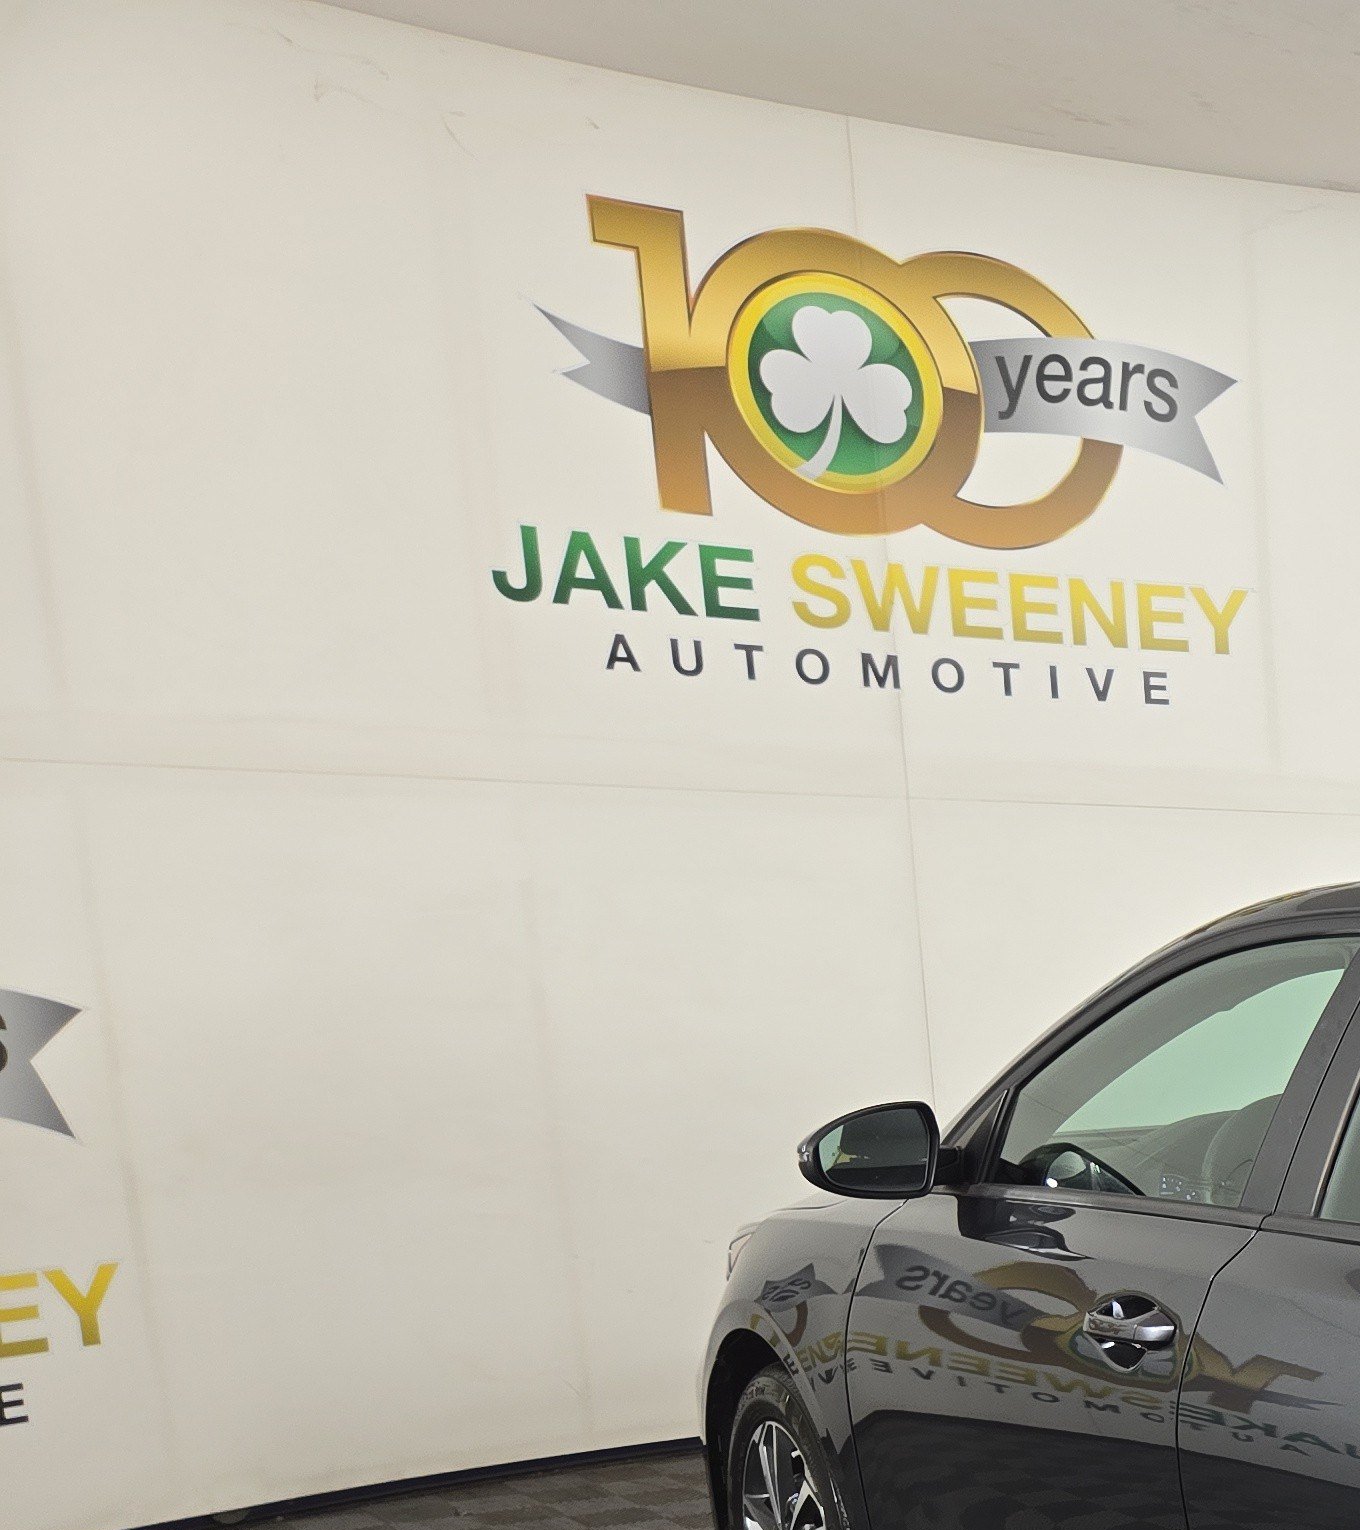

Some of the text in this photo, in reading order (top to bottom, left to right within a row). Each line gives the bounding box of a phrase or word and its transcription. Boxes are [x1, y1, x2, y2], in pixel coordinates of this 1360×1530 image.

[585, 194, 1124, 552] 100
[994, 352, 1181, 425] years
[491, 525, 1250, 656] JAKE SWEENEY
[605, 633, 1172, 707] AUTOMOTIVE
